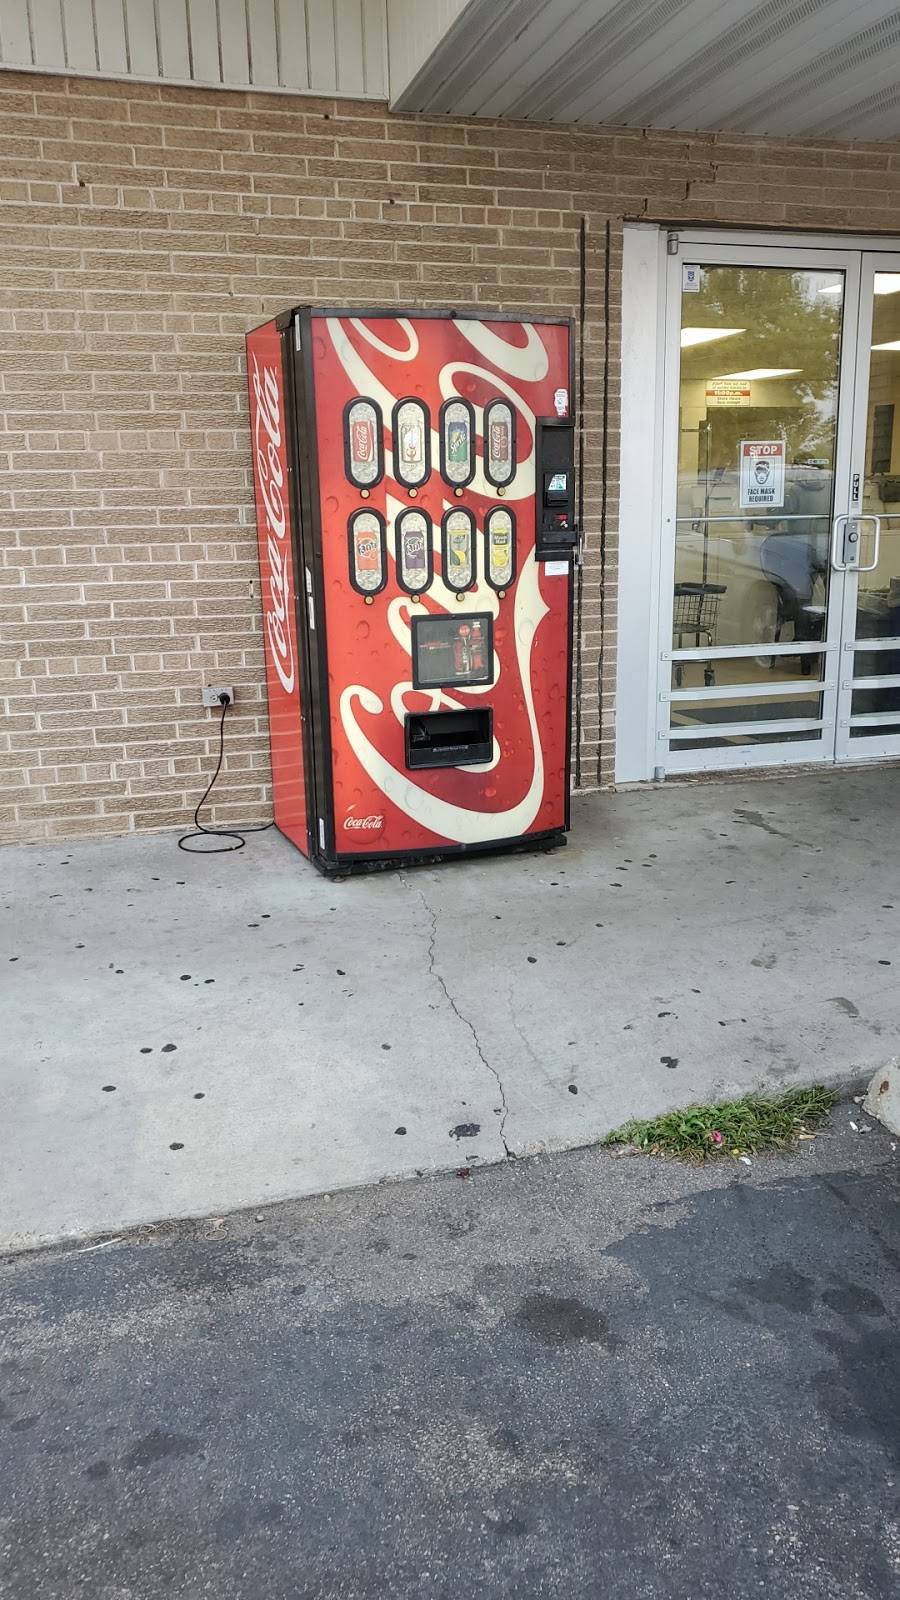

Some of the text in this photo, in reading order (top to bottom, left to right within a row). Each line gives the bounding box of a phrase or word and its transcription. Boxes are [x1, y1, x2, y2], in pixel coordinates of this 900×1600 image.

[450, 433, 467, 454] Sprite
[749, 445, 778, 455] STOP
[852, 474, 860, 501] PULL
[748, 495, 774, 503] REQUIRED
